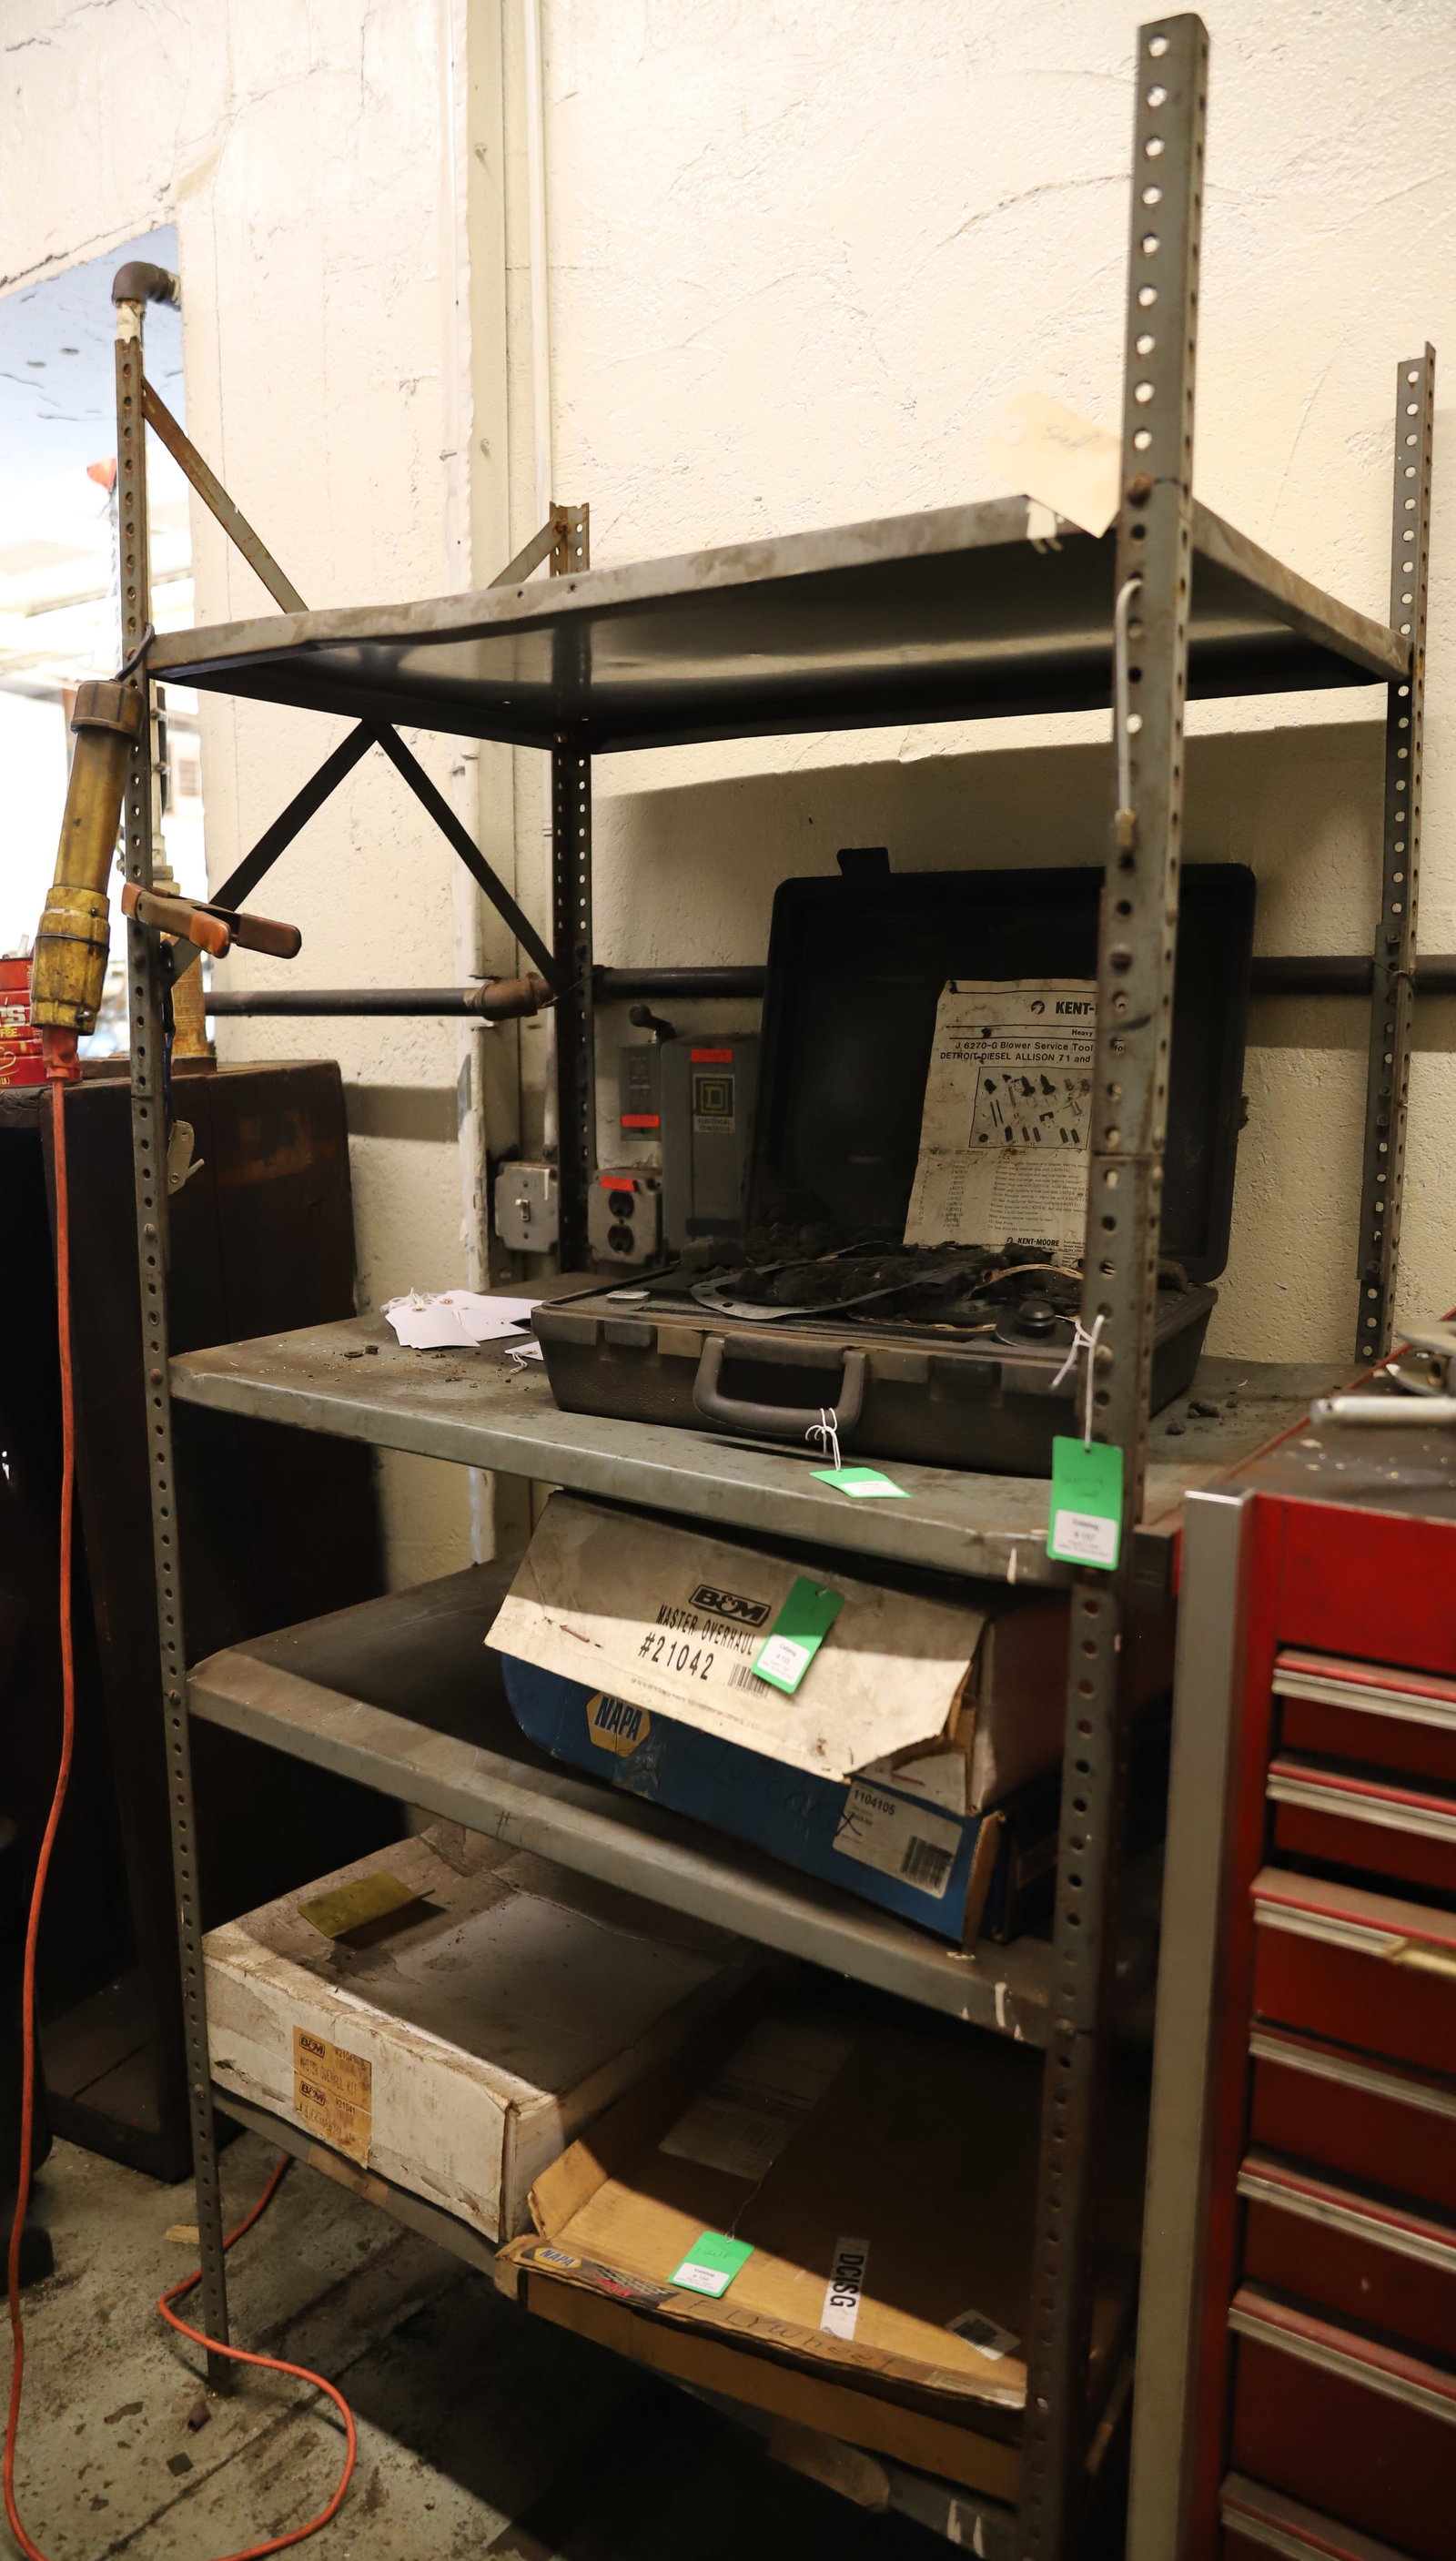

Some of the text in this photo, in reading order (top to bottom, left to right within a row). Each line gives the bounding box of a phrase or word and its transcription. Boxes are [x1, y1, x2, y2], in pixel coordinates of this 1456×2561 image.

[1056, 1001, 1097, 1016] KENT-
[1072, 1029, 1094, 1038] Heavy
[964, 1042, 998, 1050] 6270-G
[1000, 1041, 1031, 1050] Blower
[1034, 1041, 1069, 1051] Service
[1015, 1053, 1055, 1061] ALLISON
[1074, 1055, 1091, 1063] and
[1017, 1238, 1060, 1247] KENT-MOORE
[693, 1587, 767, 1623] B&M
[656, 1604, 755, 1655] MASTER OVERHAUL
[638, 1632, 714, 1681] #21042
[594, 1696, 643, 1742] NAPA
[854, 1789, 896, 1816] 1104105
[539, 2249, 576, 2267] NAPA
[830, 2252, 864, 2308] DCISG
